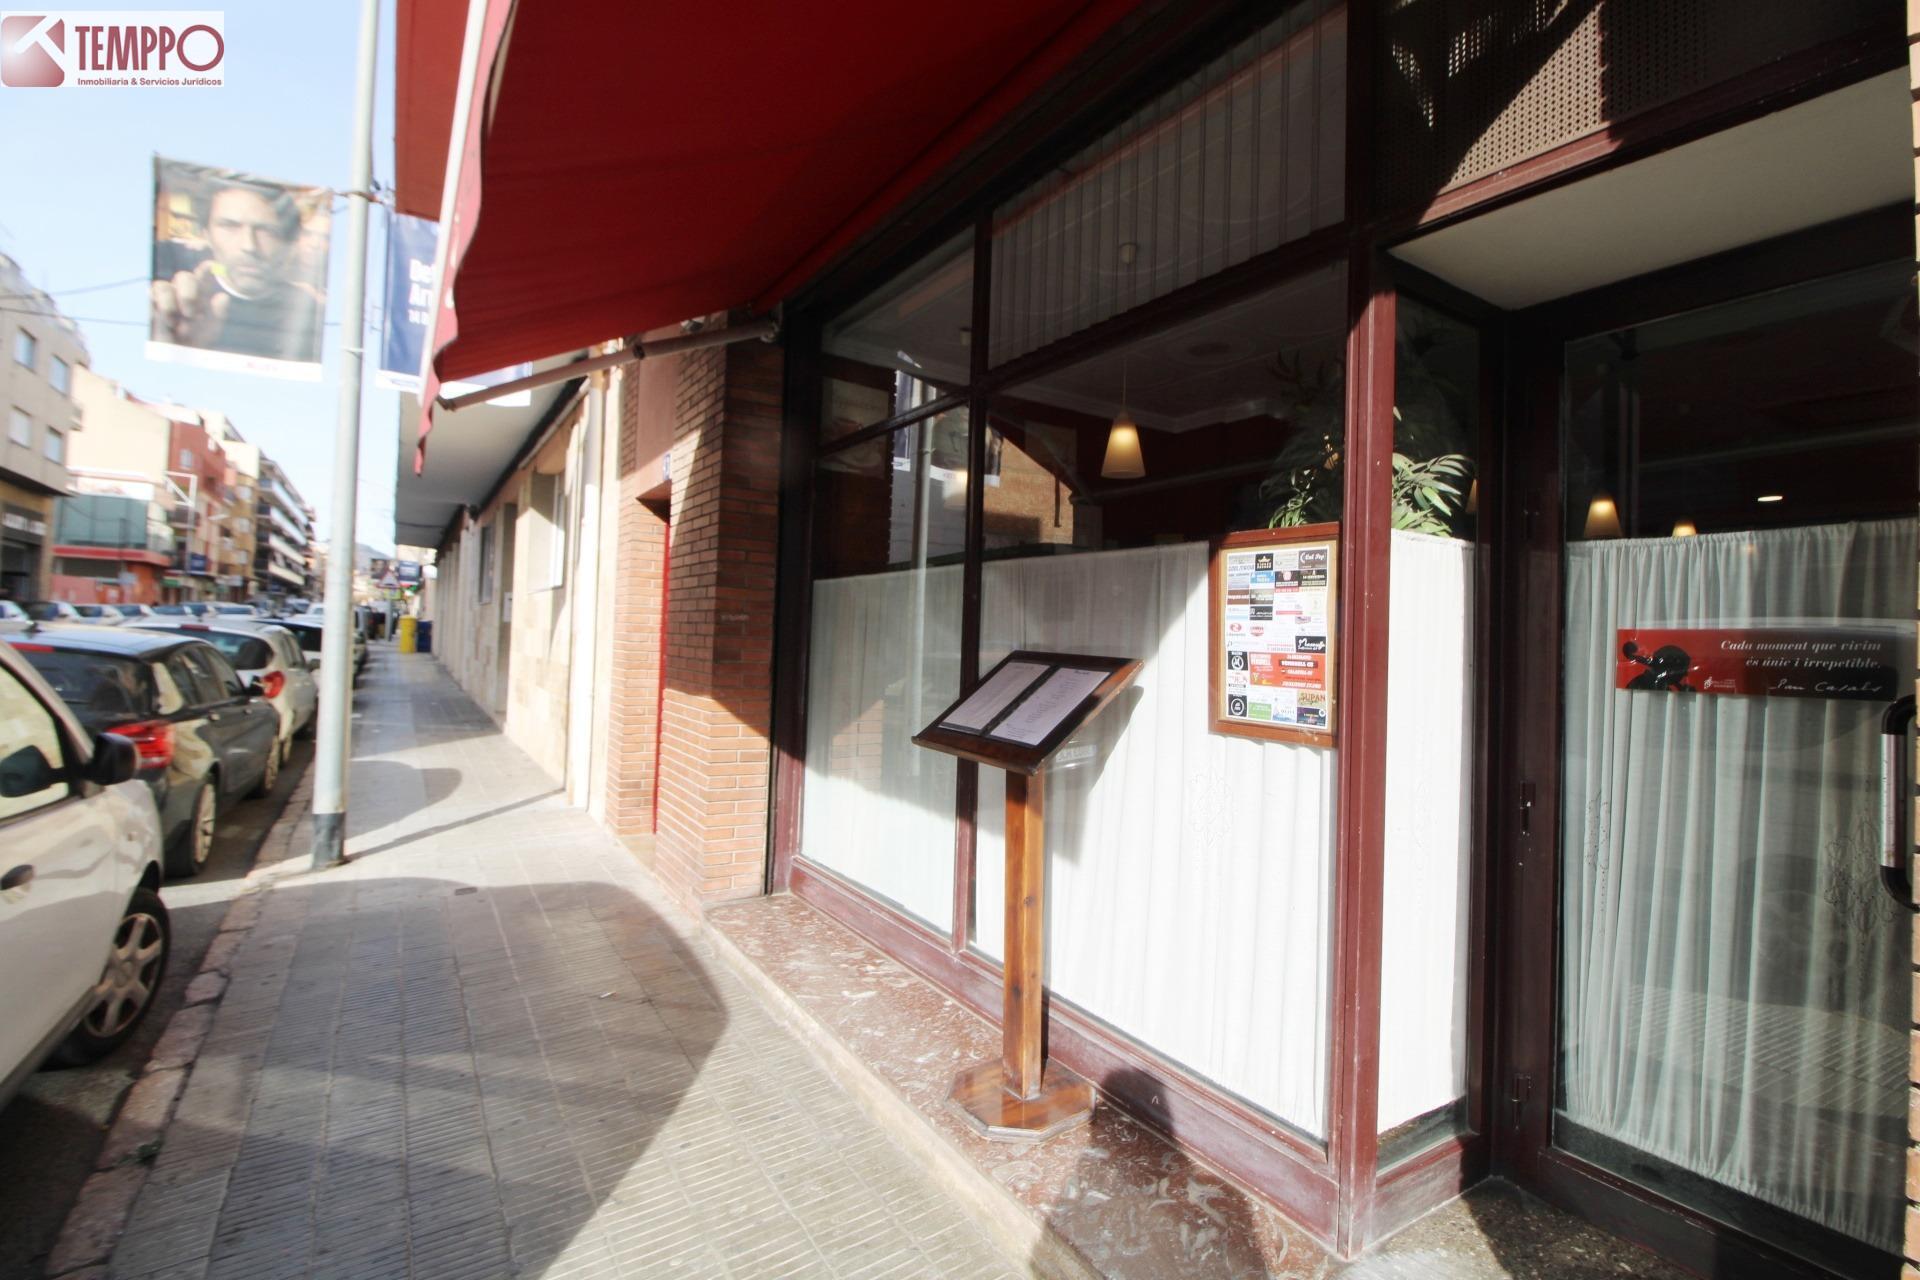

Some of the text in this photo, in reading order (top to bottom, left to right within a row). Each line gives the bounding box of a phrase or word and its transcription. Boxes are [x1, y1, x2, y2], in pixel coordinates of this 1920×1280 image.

[1720, 639, 1882, 653] Cada moment que vivim
[1794, 656, 1801, 667] i
[1803, 656, 1882, 671] irrepetible.
